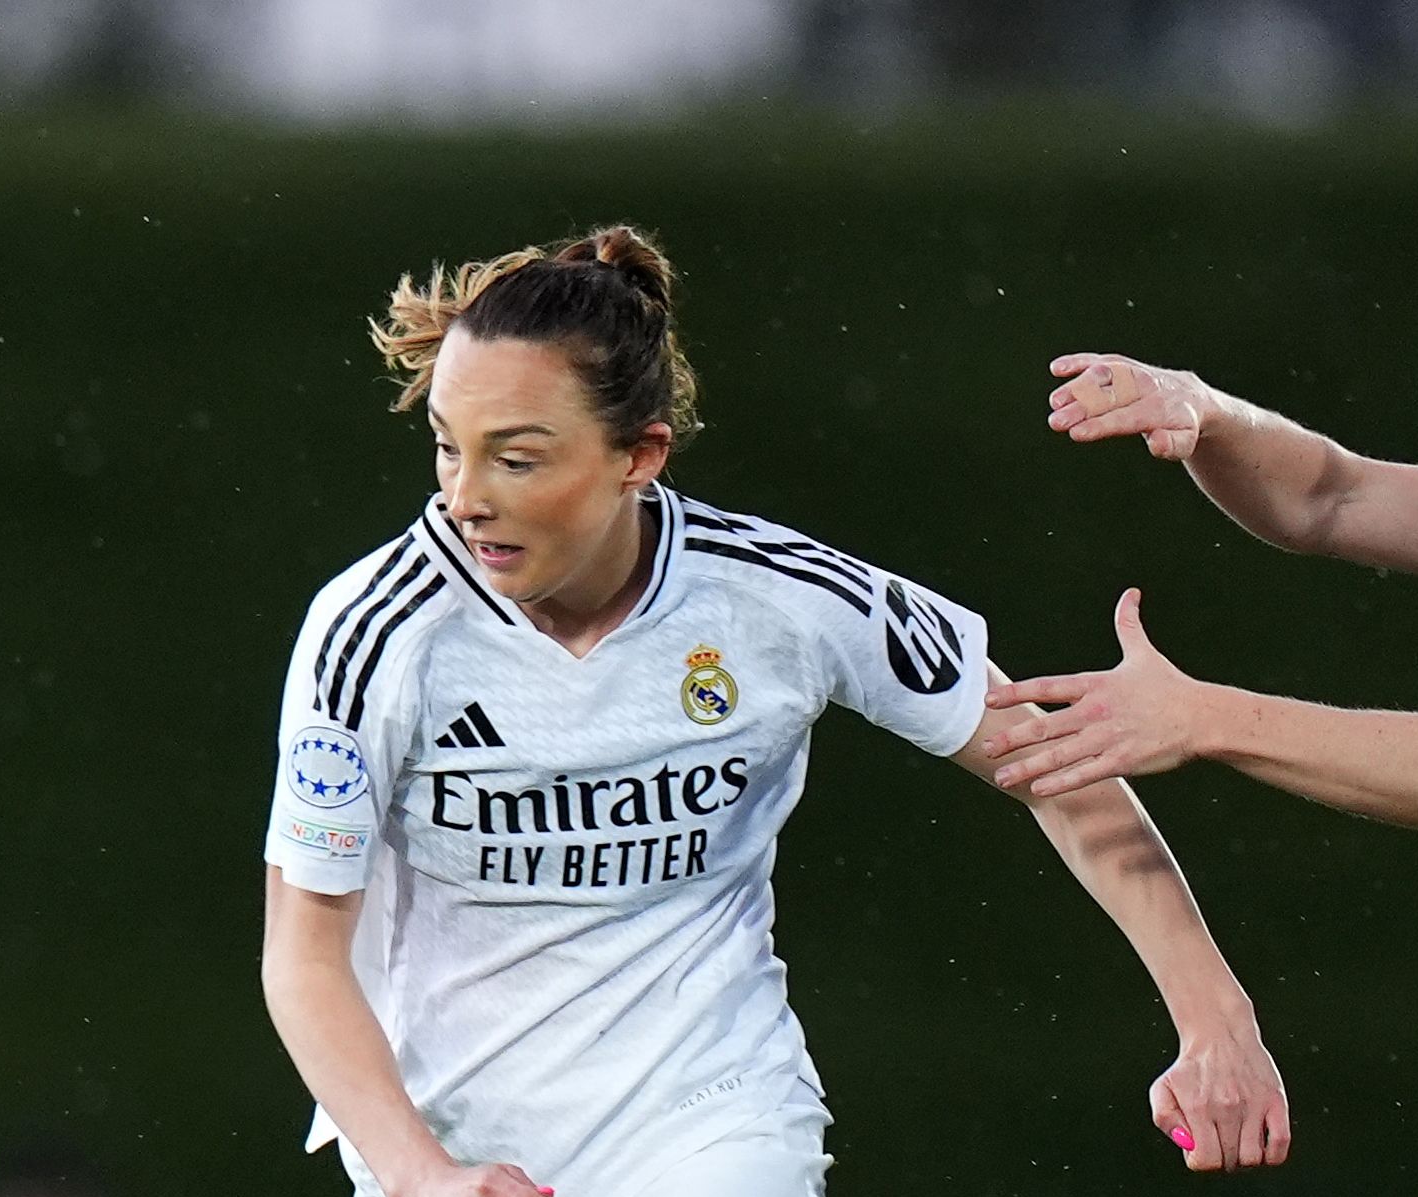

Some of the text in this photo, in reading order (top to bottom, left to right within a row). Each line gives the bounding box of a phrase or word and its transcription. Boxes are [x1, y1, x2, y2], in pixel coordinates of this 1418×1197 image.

[431, 756, 749, 834] Emirates
[479, 828, 707, 888] FLY BETTER
